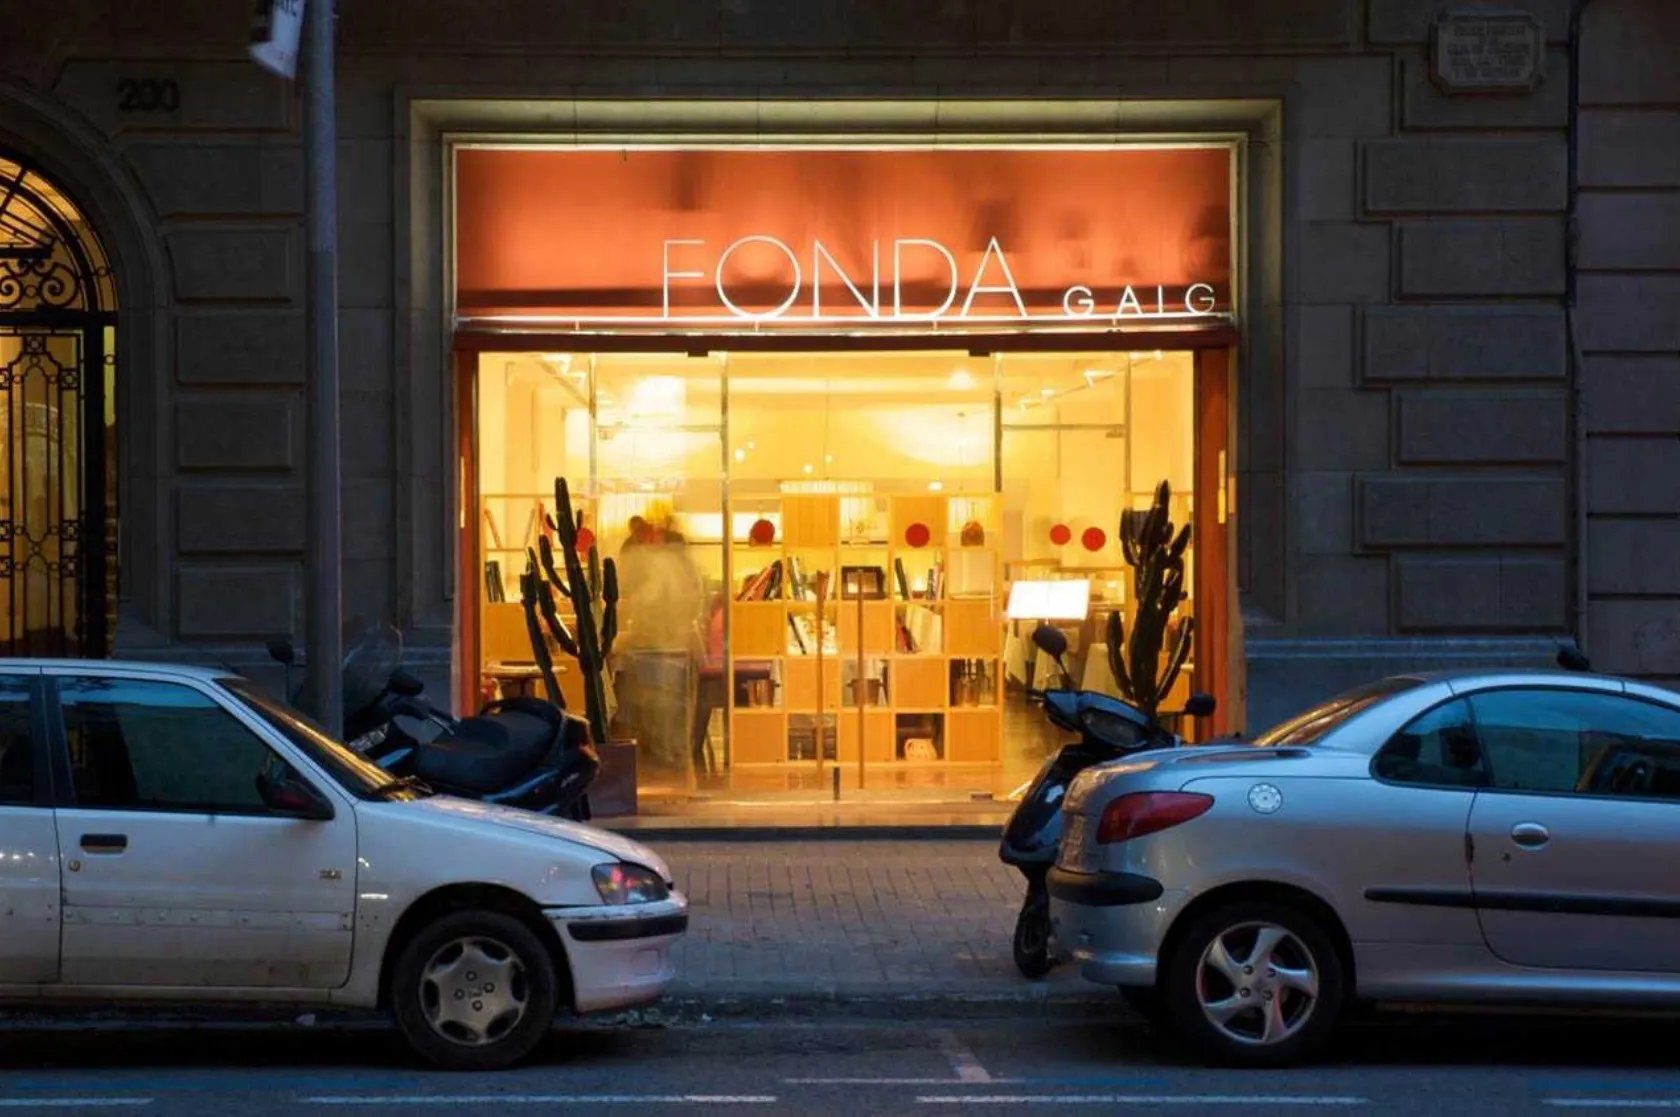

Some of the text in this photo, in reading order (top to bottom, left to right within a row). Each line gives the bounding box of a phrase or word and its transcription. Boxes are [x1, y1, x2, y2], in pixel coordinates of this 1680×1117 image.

[116, 77, 180, 112] 200
[662, 235, 1216, 320] FONDA GAIG
